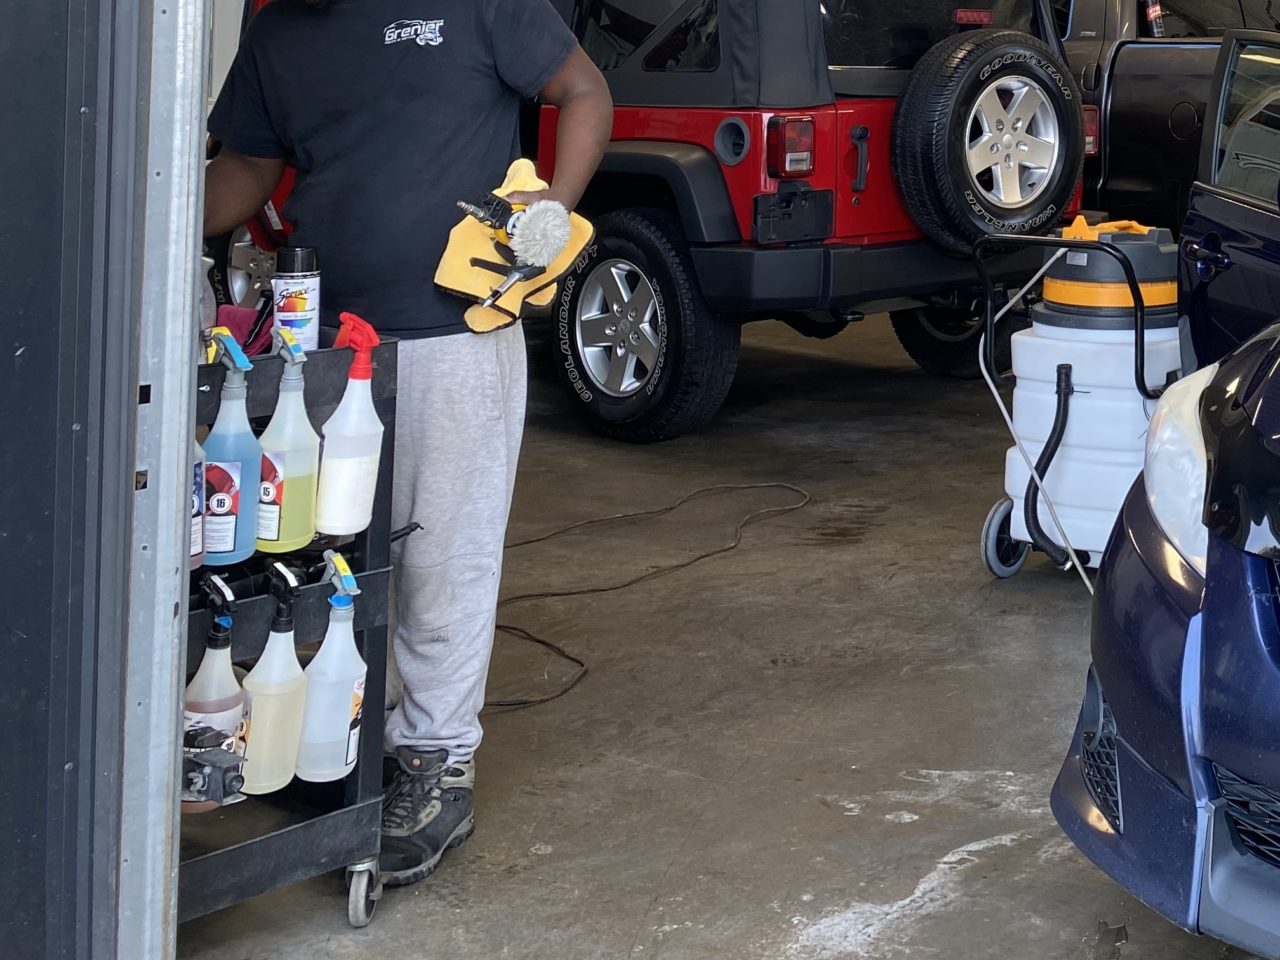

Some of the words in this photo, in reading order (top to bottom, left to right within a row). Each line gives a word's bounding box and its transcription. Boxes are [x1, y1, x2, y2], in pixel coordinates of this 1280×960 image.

[385, 21, 444, 41] Grenier
[979, 53, 1072, 100] GOODYEAR
[964, 190, 1057, 232] WRANGLER
[575, 244, 599, 274] A/T
[559, 276, 593, 403] GEOLANDAR
[646, 277, 668, 396] YOKOHAMA
[216, 498, 226, 509] 16
[262, 486, 270, 497] 15
